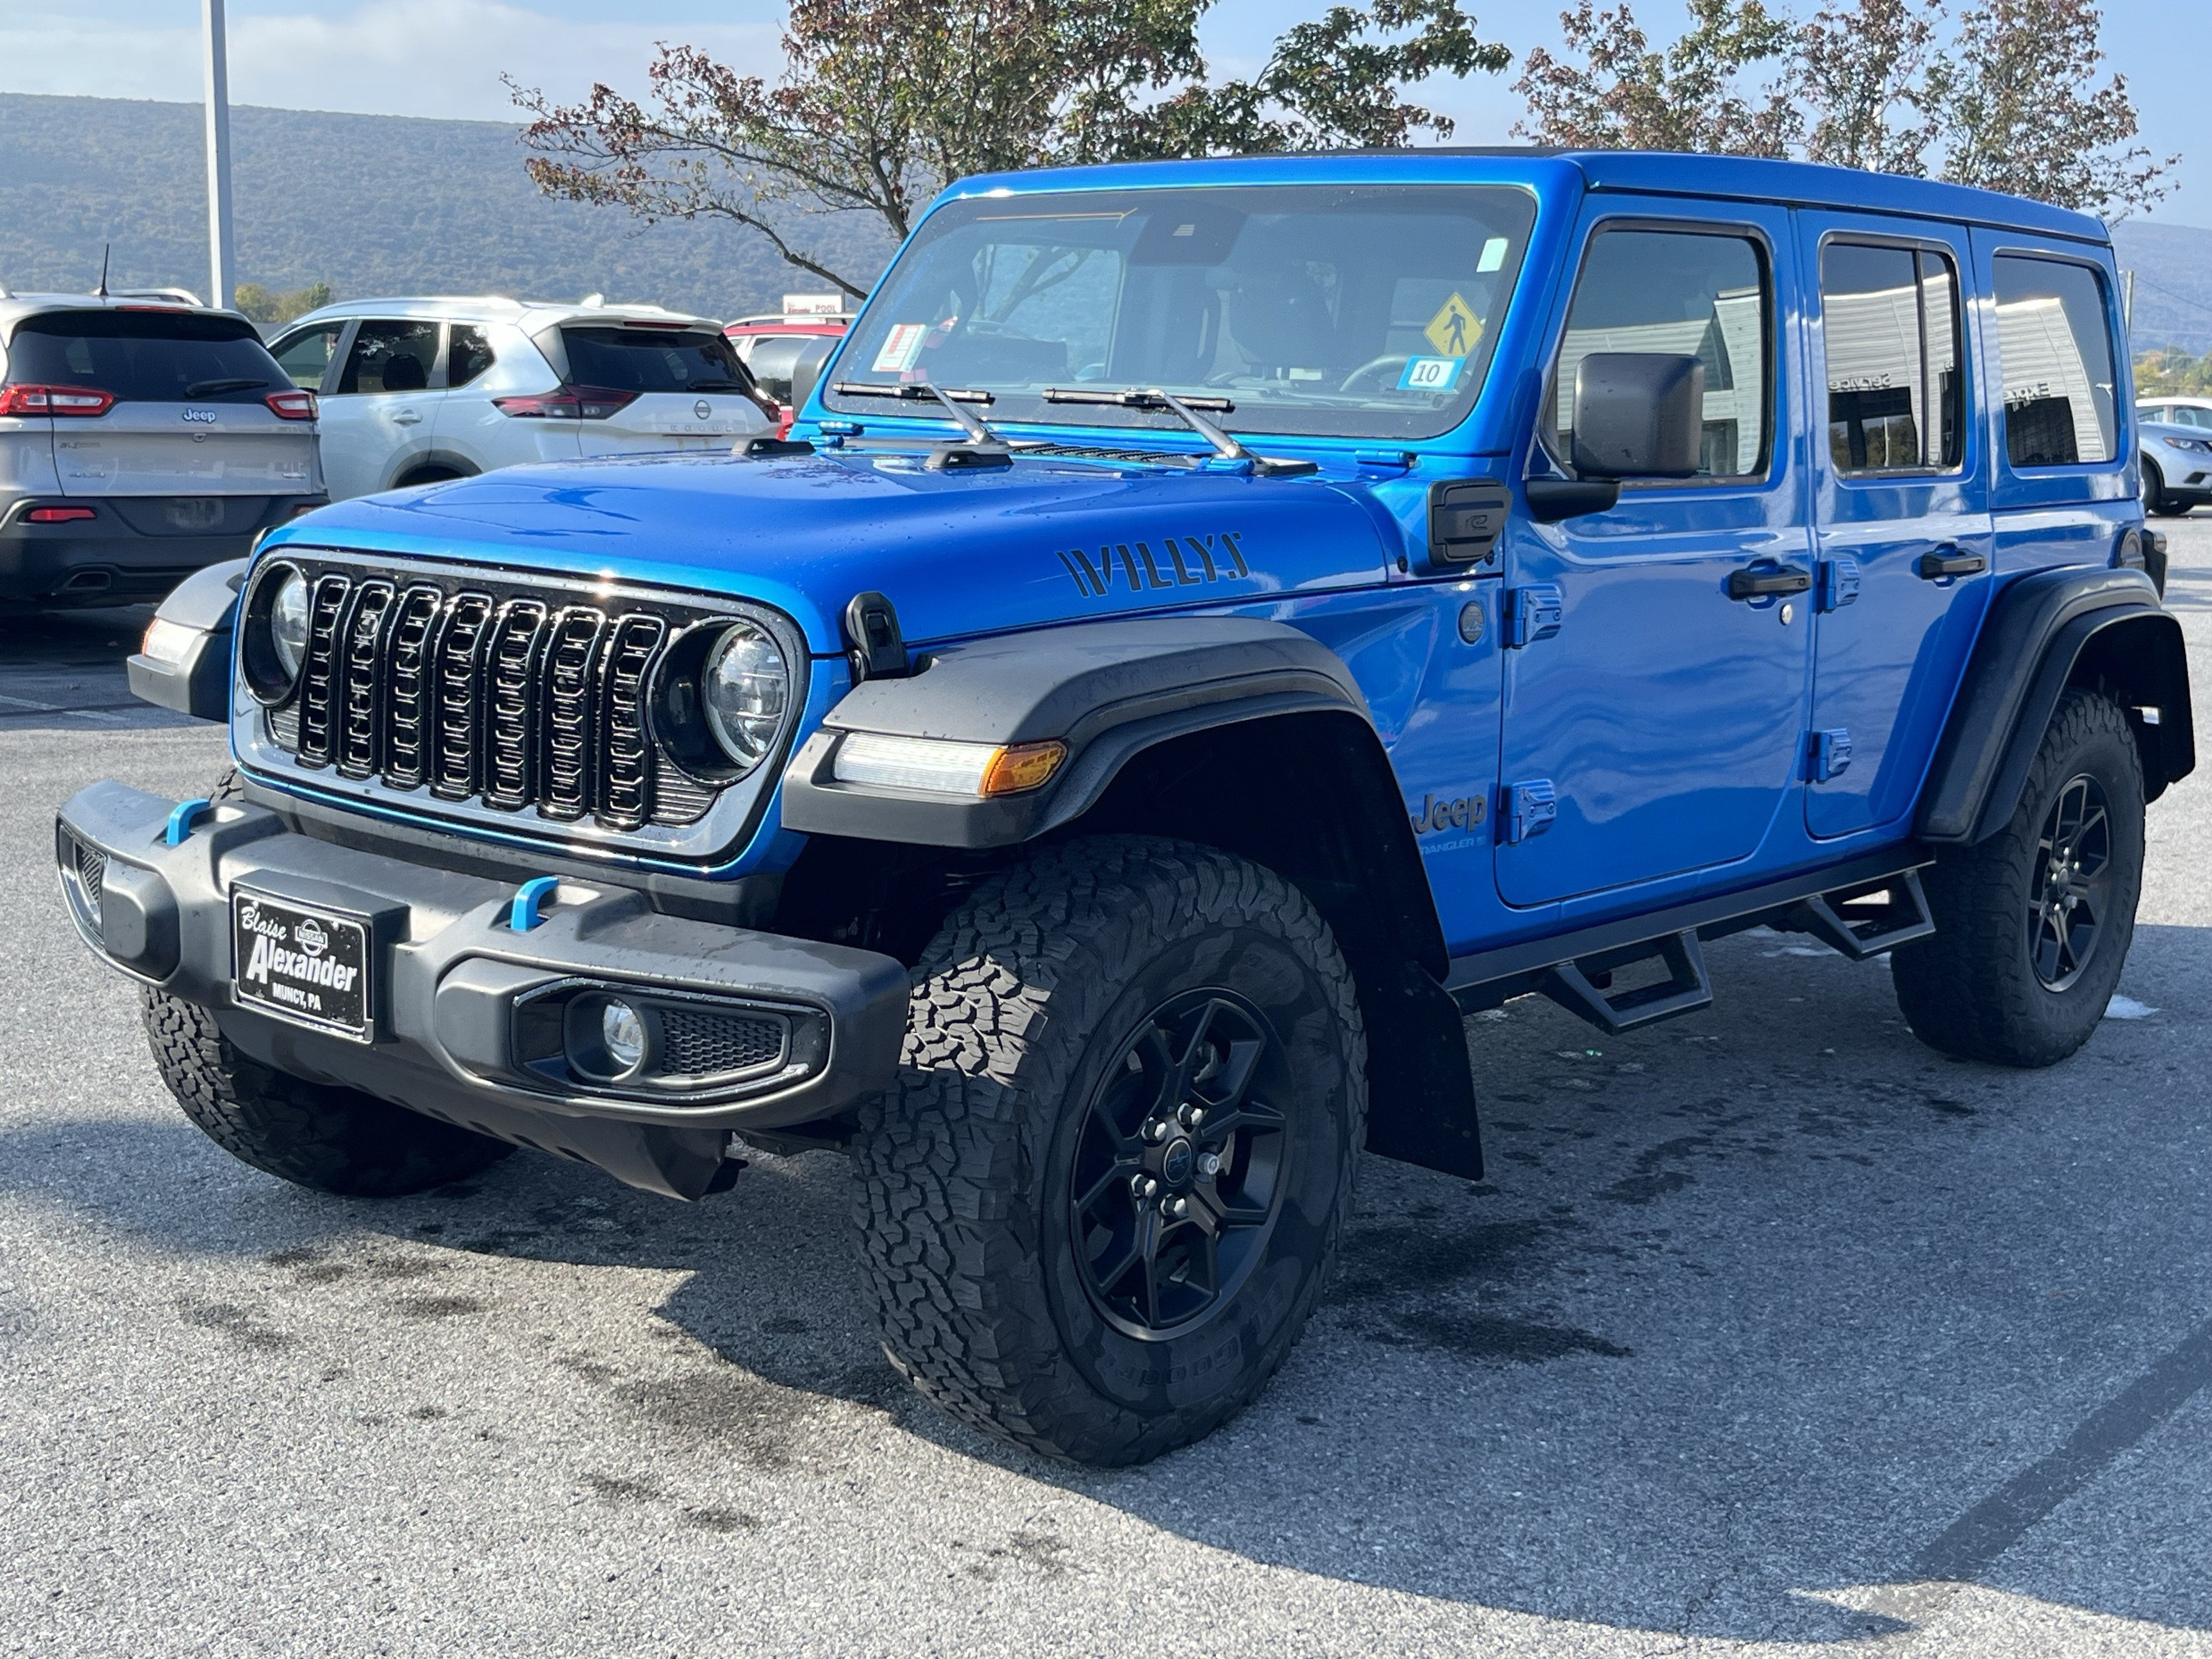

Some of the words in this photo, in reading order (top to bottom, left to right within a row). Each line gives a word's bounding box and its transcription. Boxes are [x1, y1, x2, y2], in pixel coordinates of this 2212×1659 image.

[1413, 364, 1440, 382] 10
[182, 408, 216, 424] Jeep
[1056, 532, 1250, 598] WILLYS
[1412, 793, 1486, 834] Jeep
[1421, 837, 1475, 855] RANGLER
[241, 906, 287, 940] Blaise
[298, 929, 326, 944] NISSAN
[246, 933, 358, 992] Alexander
[272, 982, 307, 1009] MUNCY,
[308, 992, 321, 1011] PA
